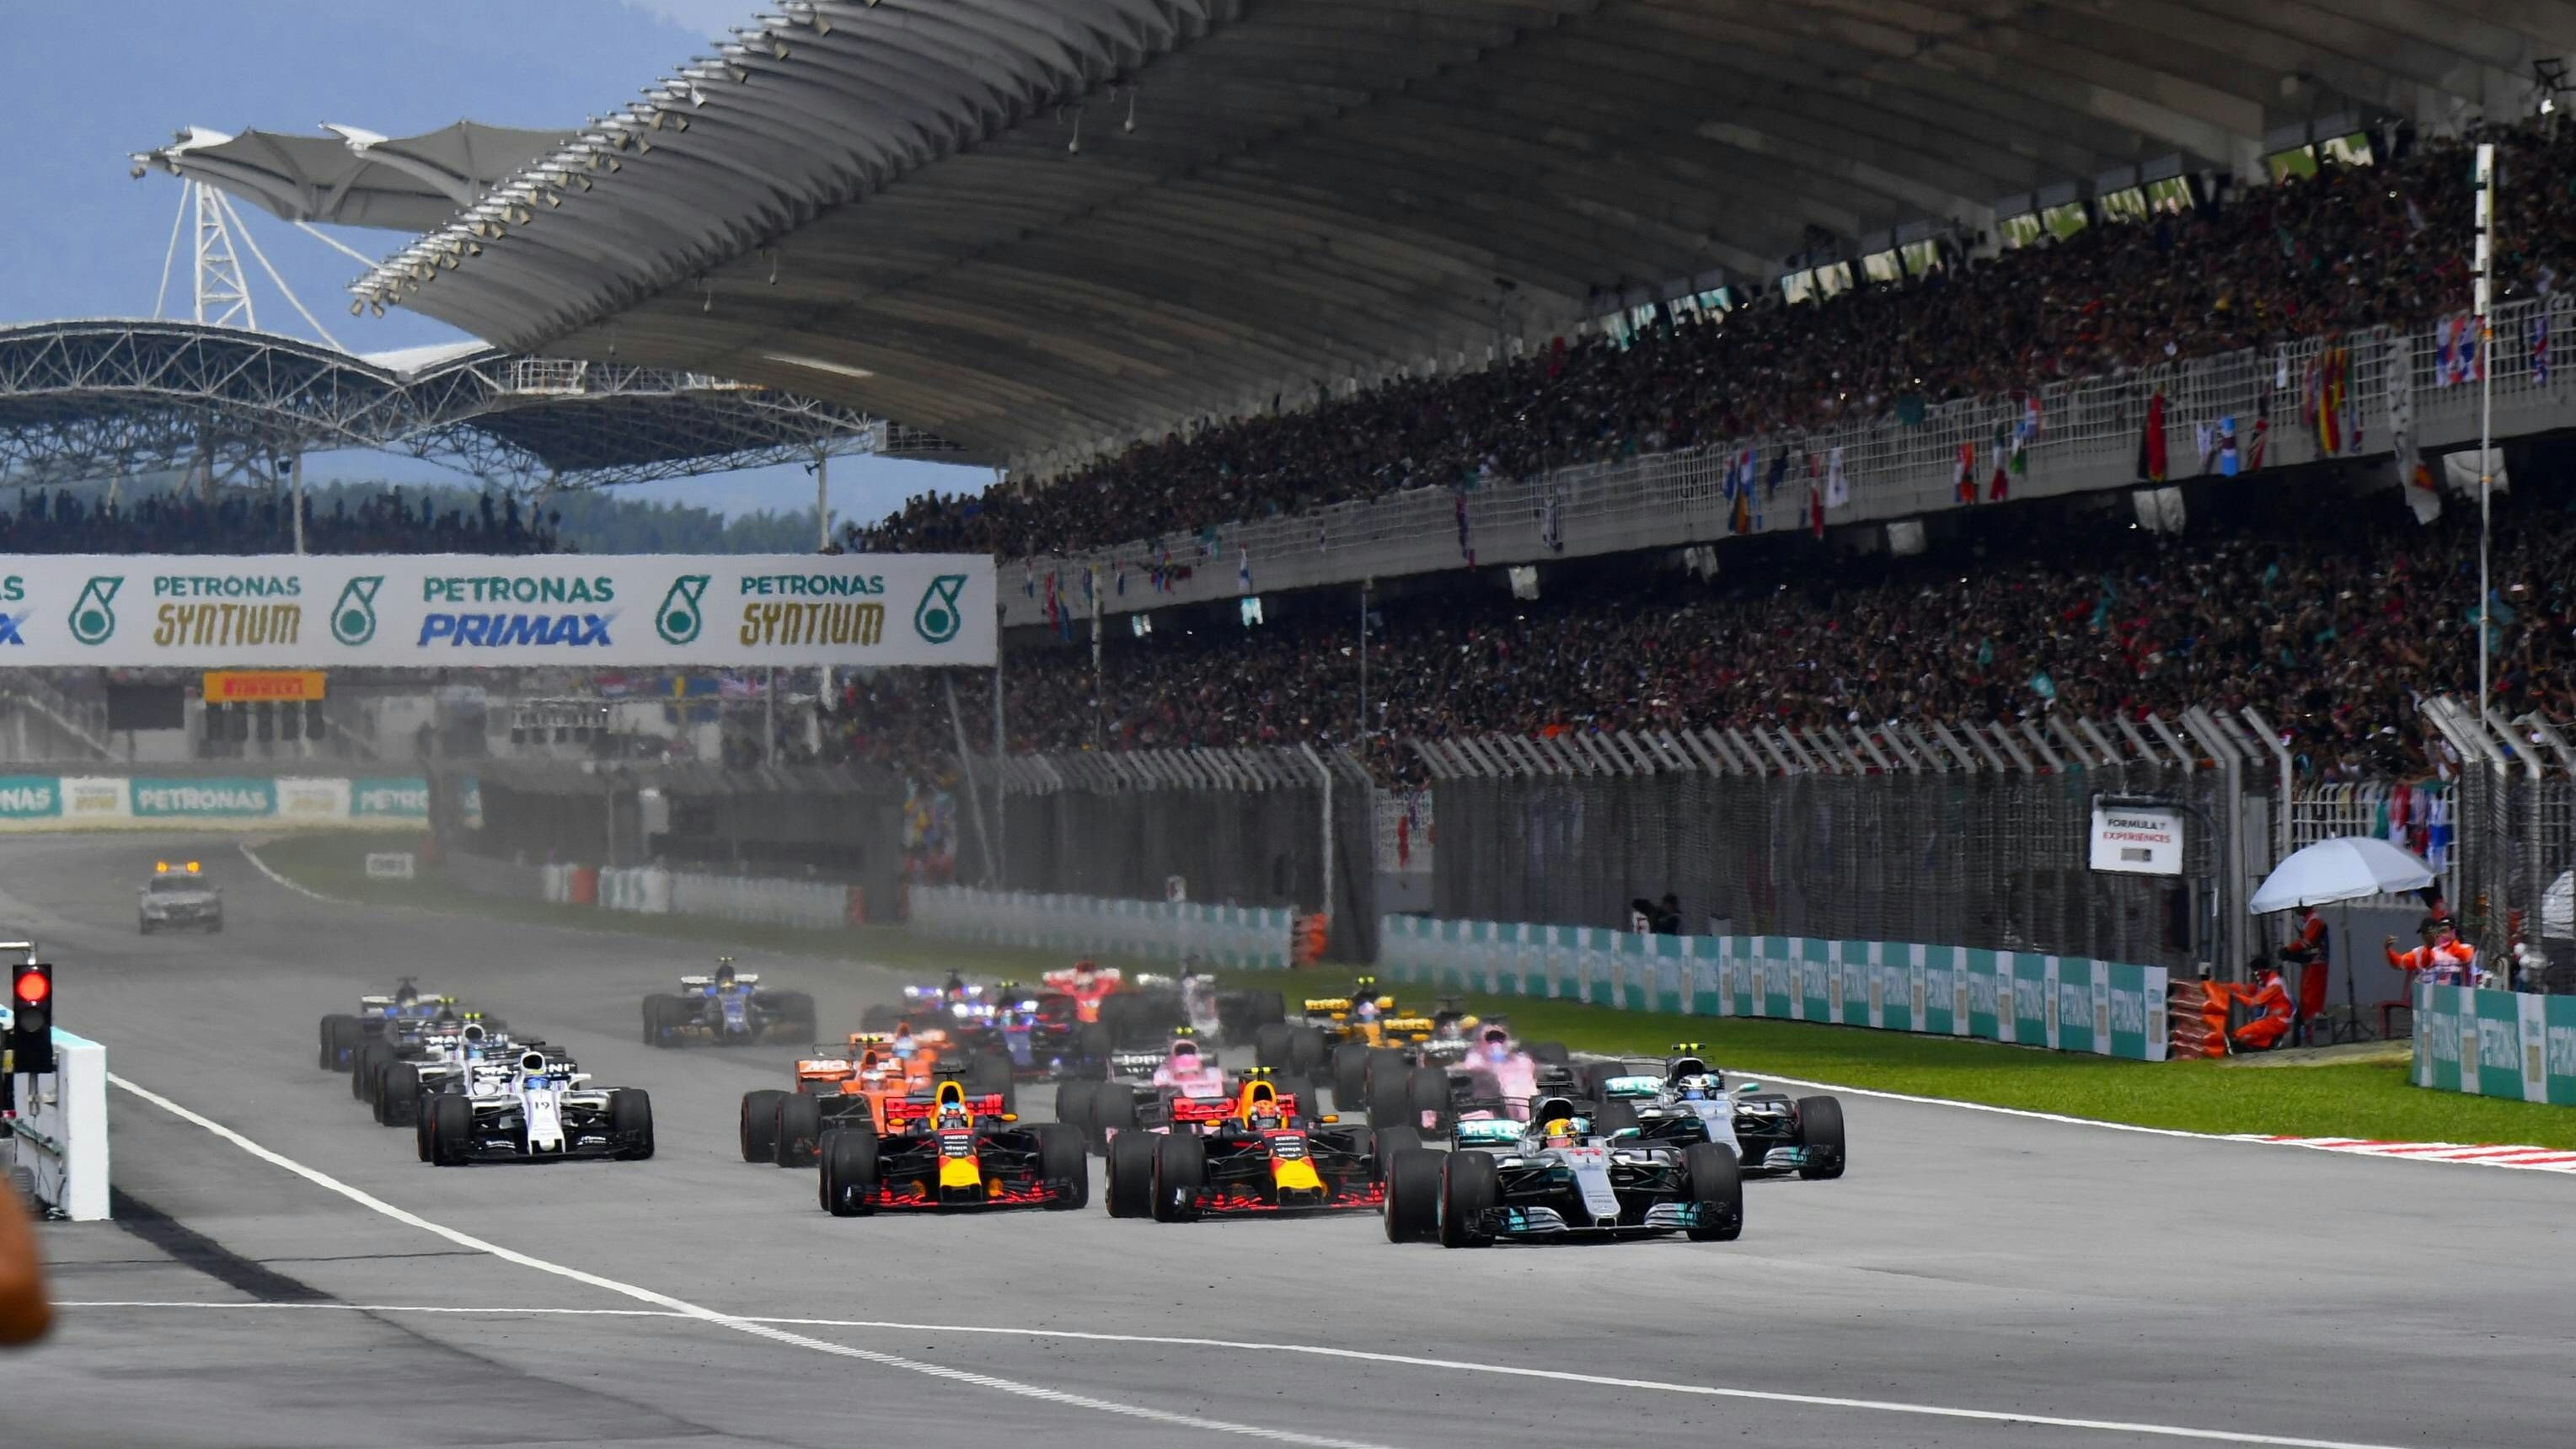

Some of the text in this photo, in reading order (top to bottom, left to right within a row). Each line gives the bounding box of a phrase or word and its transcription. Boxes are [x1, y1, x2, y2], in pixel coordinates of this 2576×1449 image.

[153, 575, 302, 596] PETRONAS
[423, 576, 615, 603] PETRONAS
[741, 575, 885, 596] PETRONAS
[153, 602, 302, 646] SYNTIUM
[417, 610, 619, 648] PRIMAX
[741, 602, 885, 646] SYNTIUM
[137, 787, 267, 810] PETRONAS
[2107, 818, 2158, 830] FORMULA
[2102, 831, 2172, 843] EXPERIENCES
[533, 1101, 550, 1109] 19
